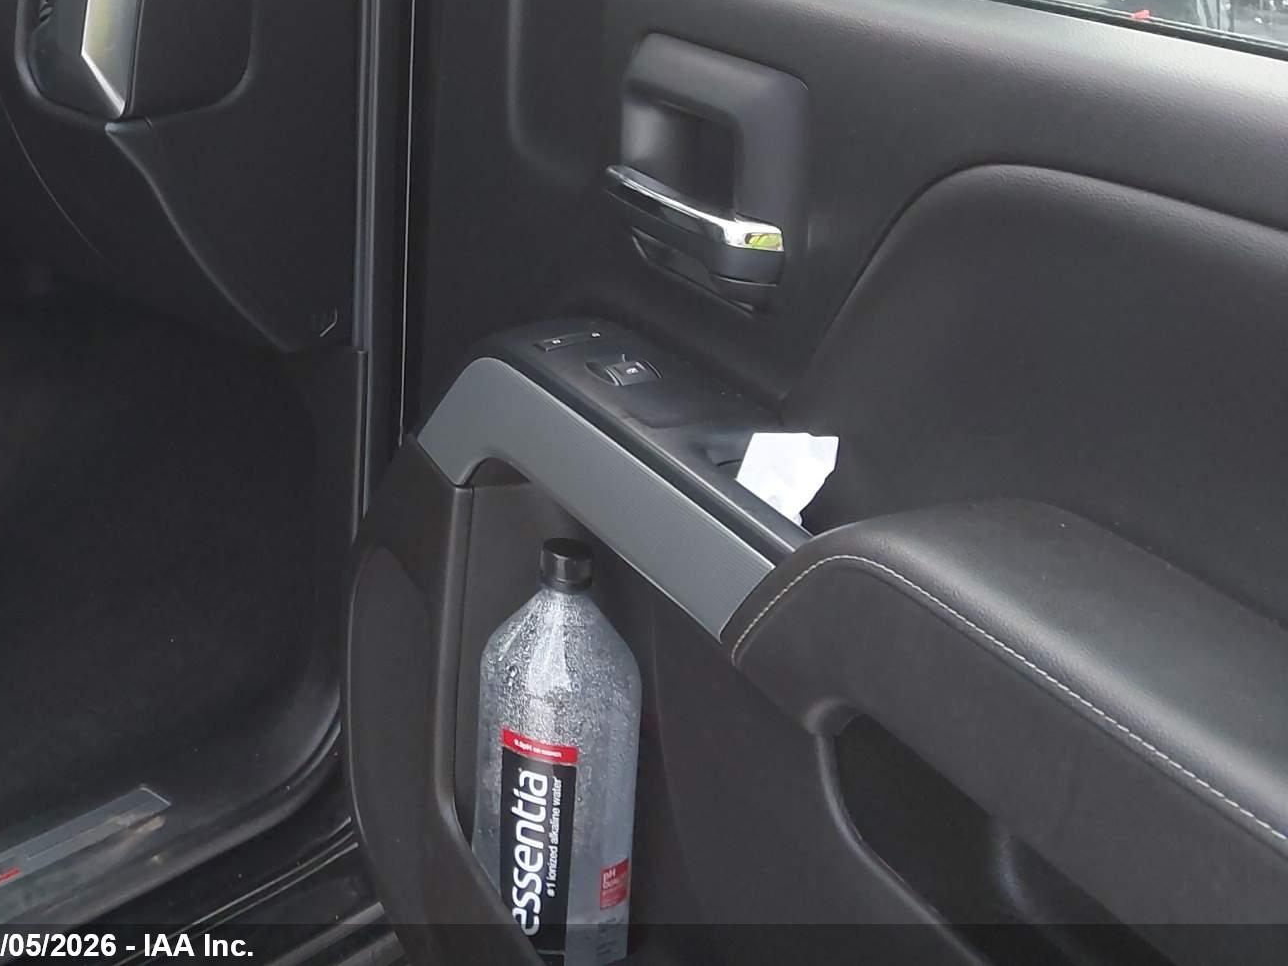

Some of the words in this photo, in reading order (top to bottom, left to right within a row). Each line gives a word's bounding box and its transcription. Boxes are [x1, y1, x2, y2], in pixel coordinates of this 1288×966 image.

[551, 777, 563, 807] water
[548, 807, 561, 845] alkaline
[512, 769, 548, 936] essentia
[546, 846, 559, 881] ionized
